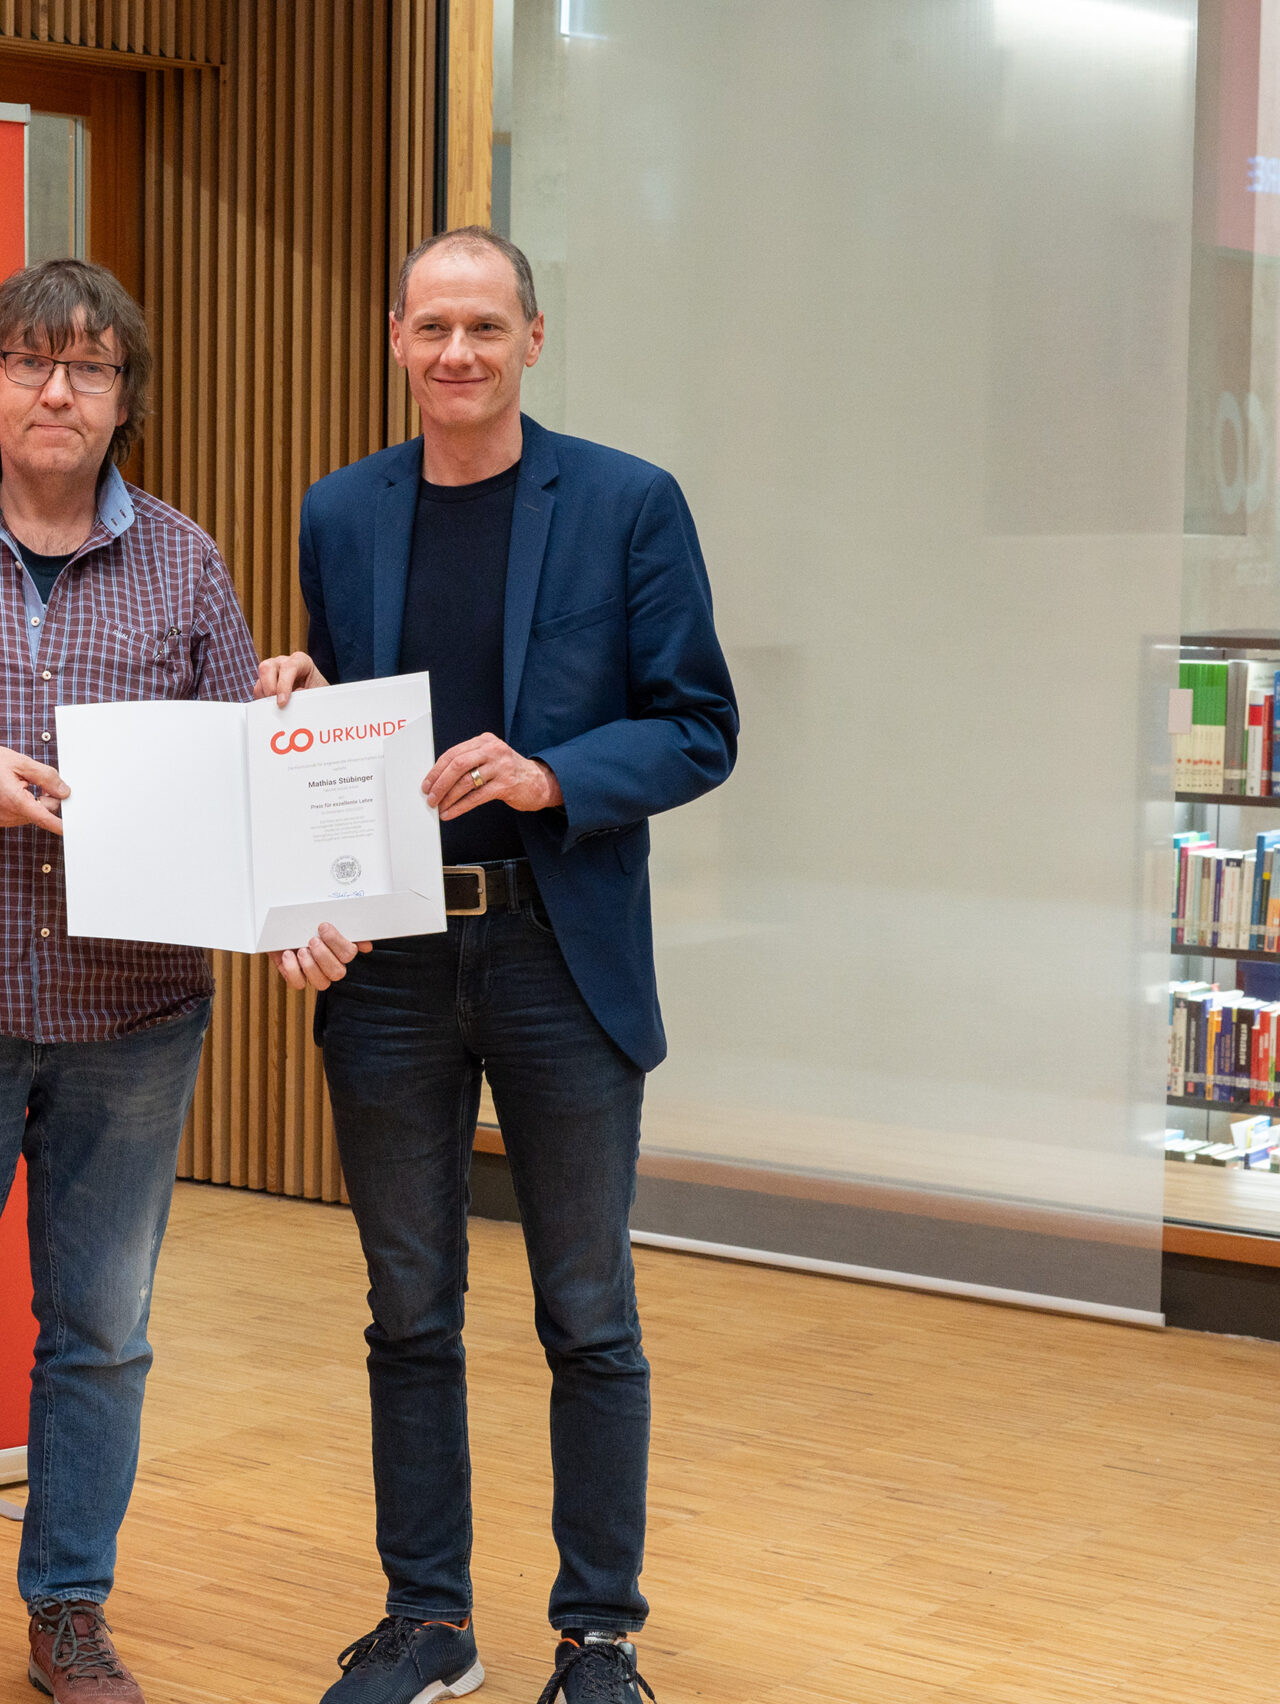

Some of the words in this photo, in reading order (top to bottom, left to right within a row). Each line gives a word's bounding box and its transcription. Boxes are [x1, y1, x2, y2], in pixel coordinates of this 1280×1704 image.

[308, 779, 337, 789] Mathias
[338, 774, 374, 785] Stübinger
[332, 799, 358, 807] exzellente
